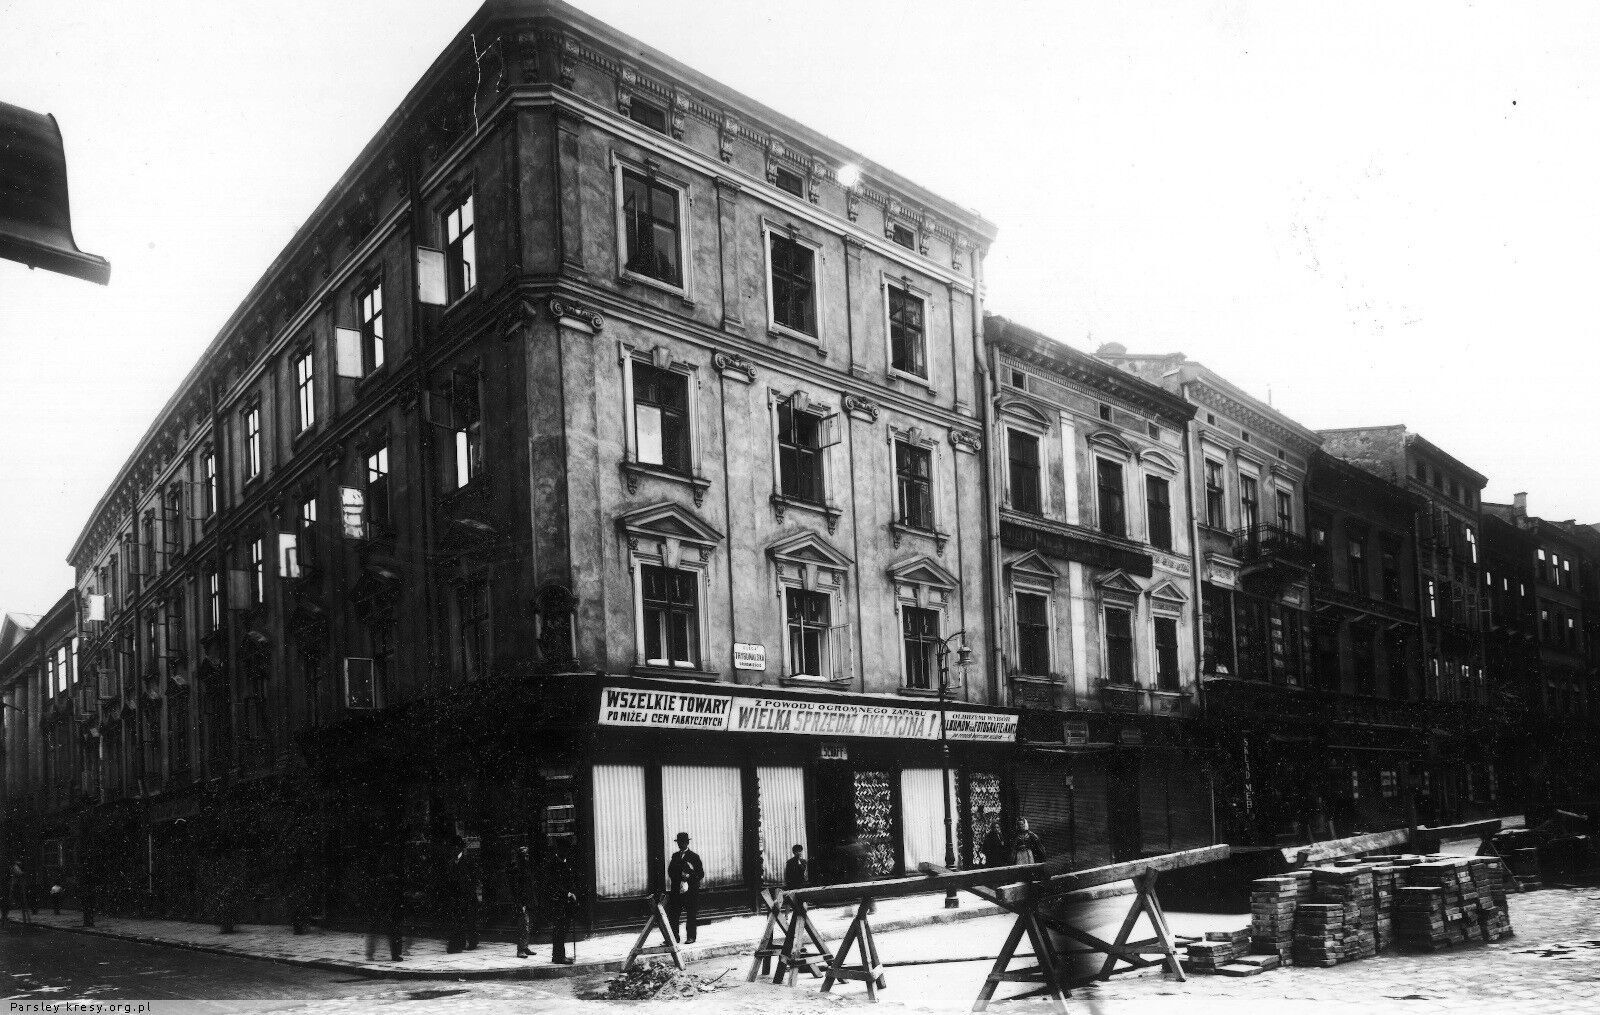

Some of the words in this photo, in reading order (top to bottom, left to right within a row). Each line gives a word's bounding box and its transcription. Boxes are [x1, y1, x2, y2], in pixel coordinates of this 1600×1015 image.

[607, 690, 677, 711] WSZELKIE
[680, 696, 729, 714] TOWARY
[765, 701, 815, 710] POWODU
[818, 705, 888, 714] OGROMNEGO
[892, 709, 927, 717] ZAPASU
[607, 711, 619, 721] PO
[620, 710, 648, 723] NIŻEJ
[651, 713, 670, 724] CEN
[671, 715, 723, 727] FABRYCZNYCH
[739, 707, 792, 730] WIELKA
[860, 714, 925, 736] OKAZYJNA
